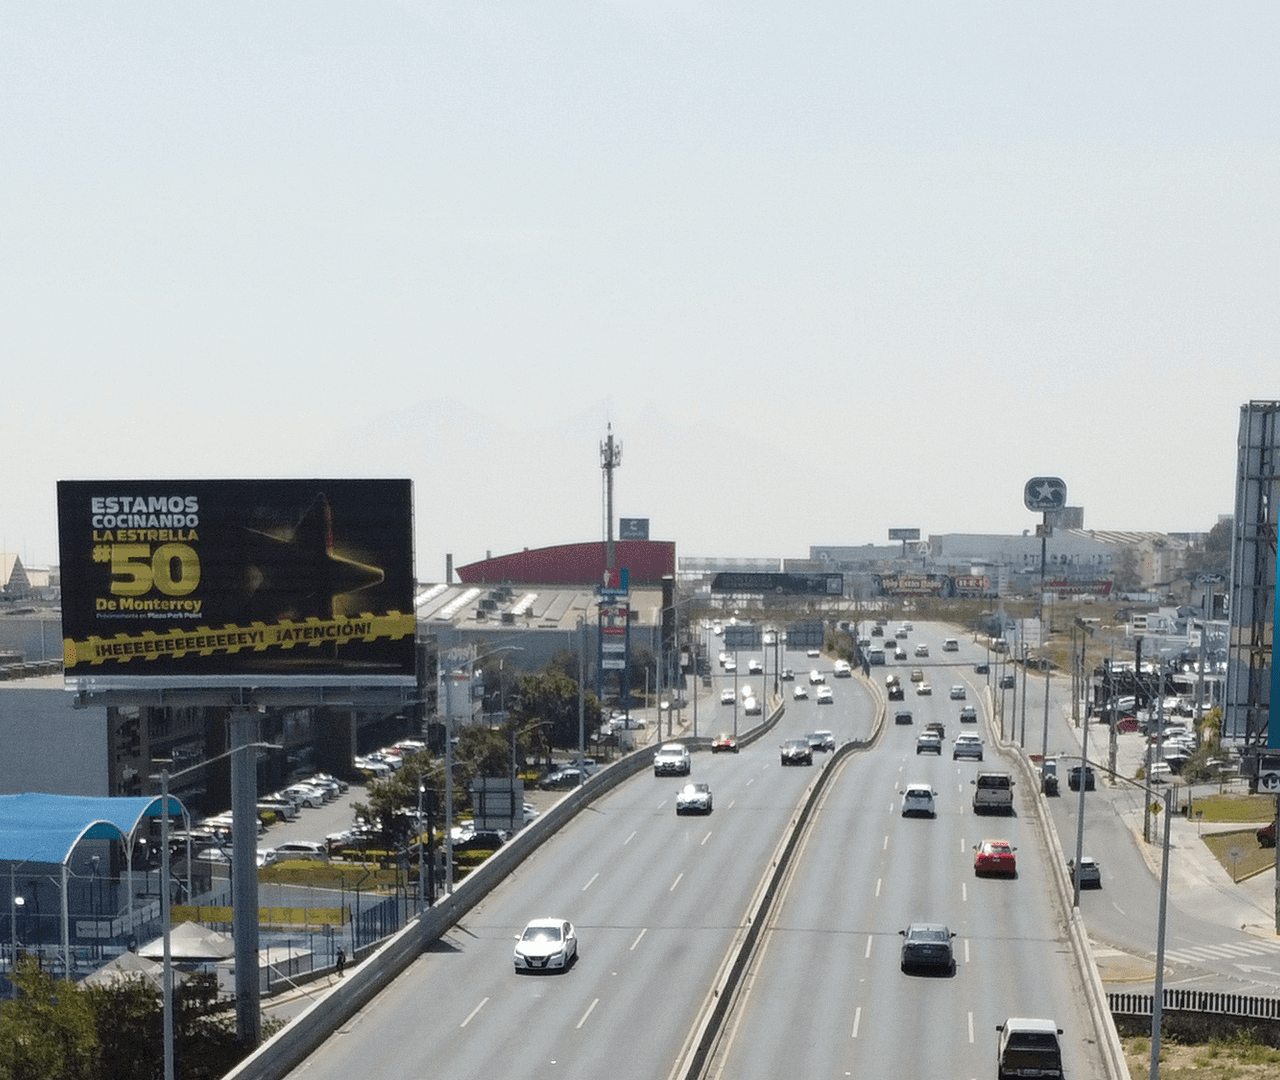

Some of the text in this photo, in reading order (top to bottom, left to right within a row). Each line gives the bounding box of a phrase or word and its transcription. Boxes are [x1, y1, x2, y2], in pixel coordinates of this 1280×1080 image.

[91, 496, 199, 514] ESTAMOS
[91, 513, 200, 529] COCINANDO
[93, 529, 200, 542] LA ESTRELLA
[92, 542, 202, 597] #50
[95, 597, 202, 612] De Monterrey
